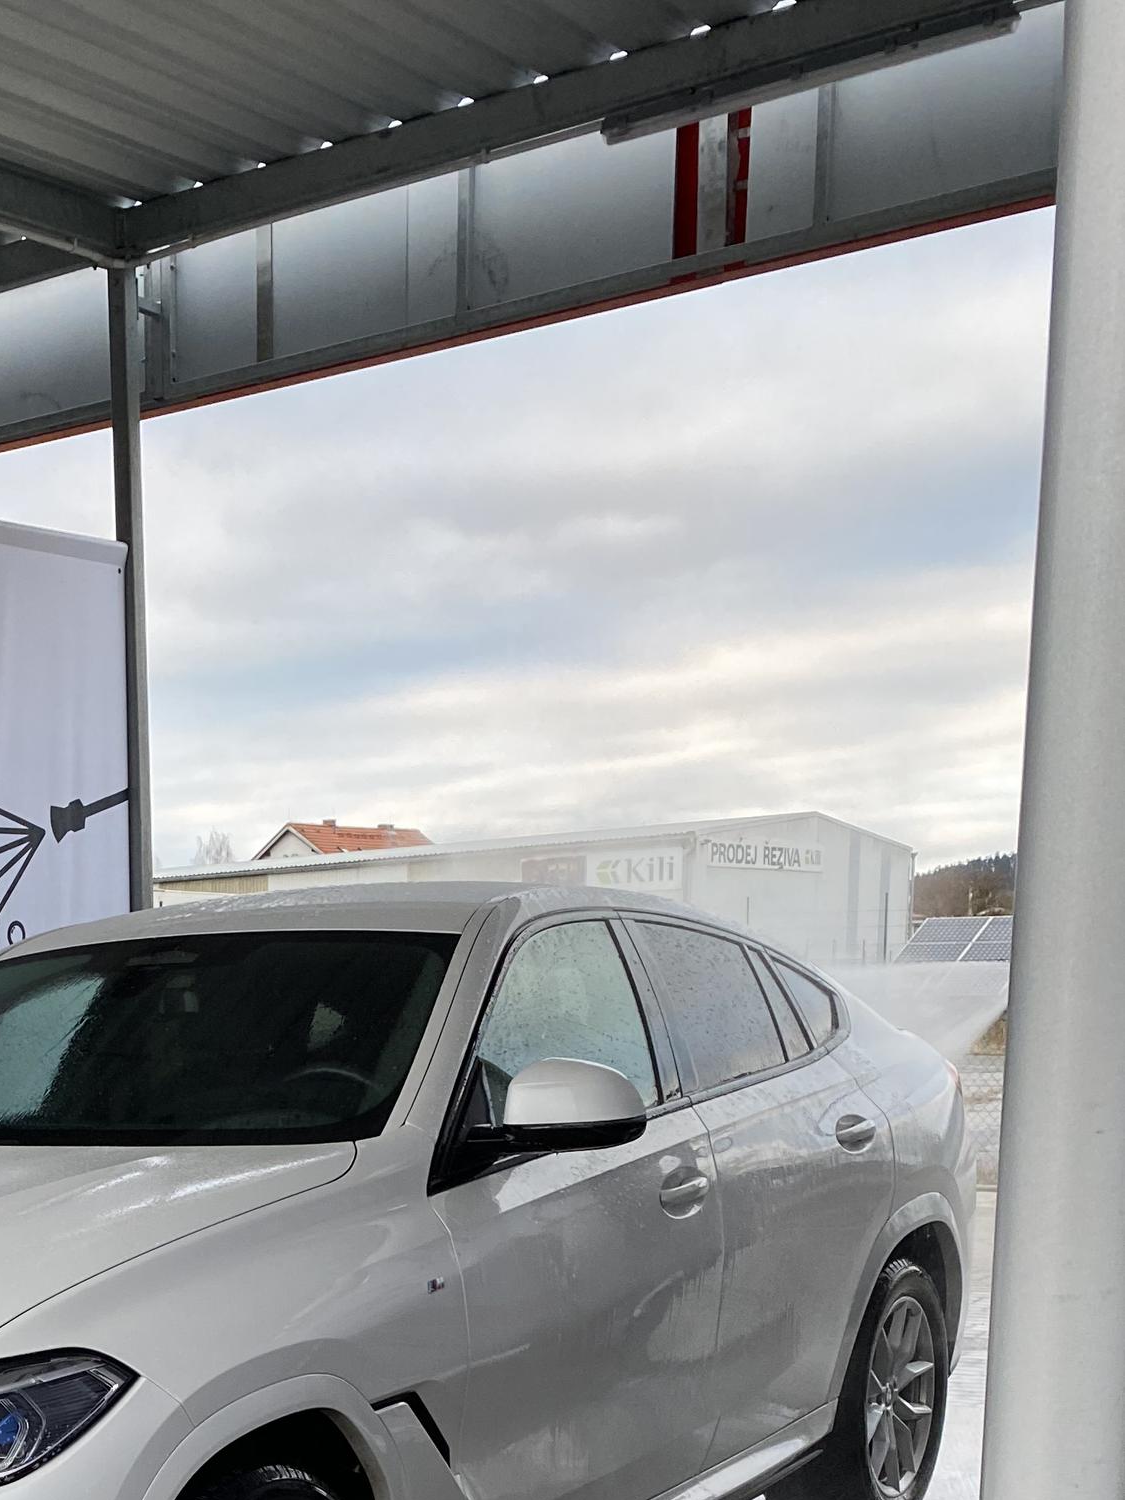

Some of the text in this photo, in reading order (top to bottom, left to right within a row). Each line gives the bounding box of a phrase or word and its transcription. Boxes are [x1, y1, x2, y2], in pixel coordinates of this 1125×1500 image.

[711, 843, 757, 864] PRODEJ
[763, 840, 801, 867] ŘEZIVA
[626, 856, 674, 883] Kili
